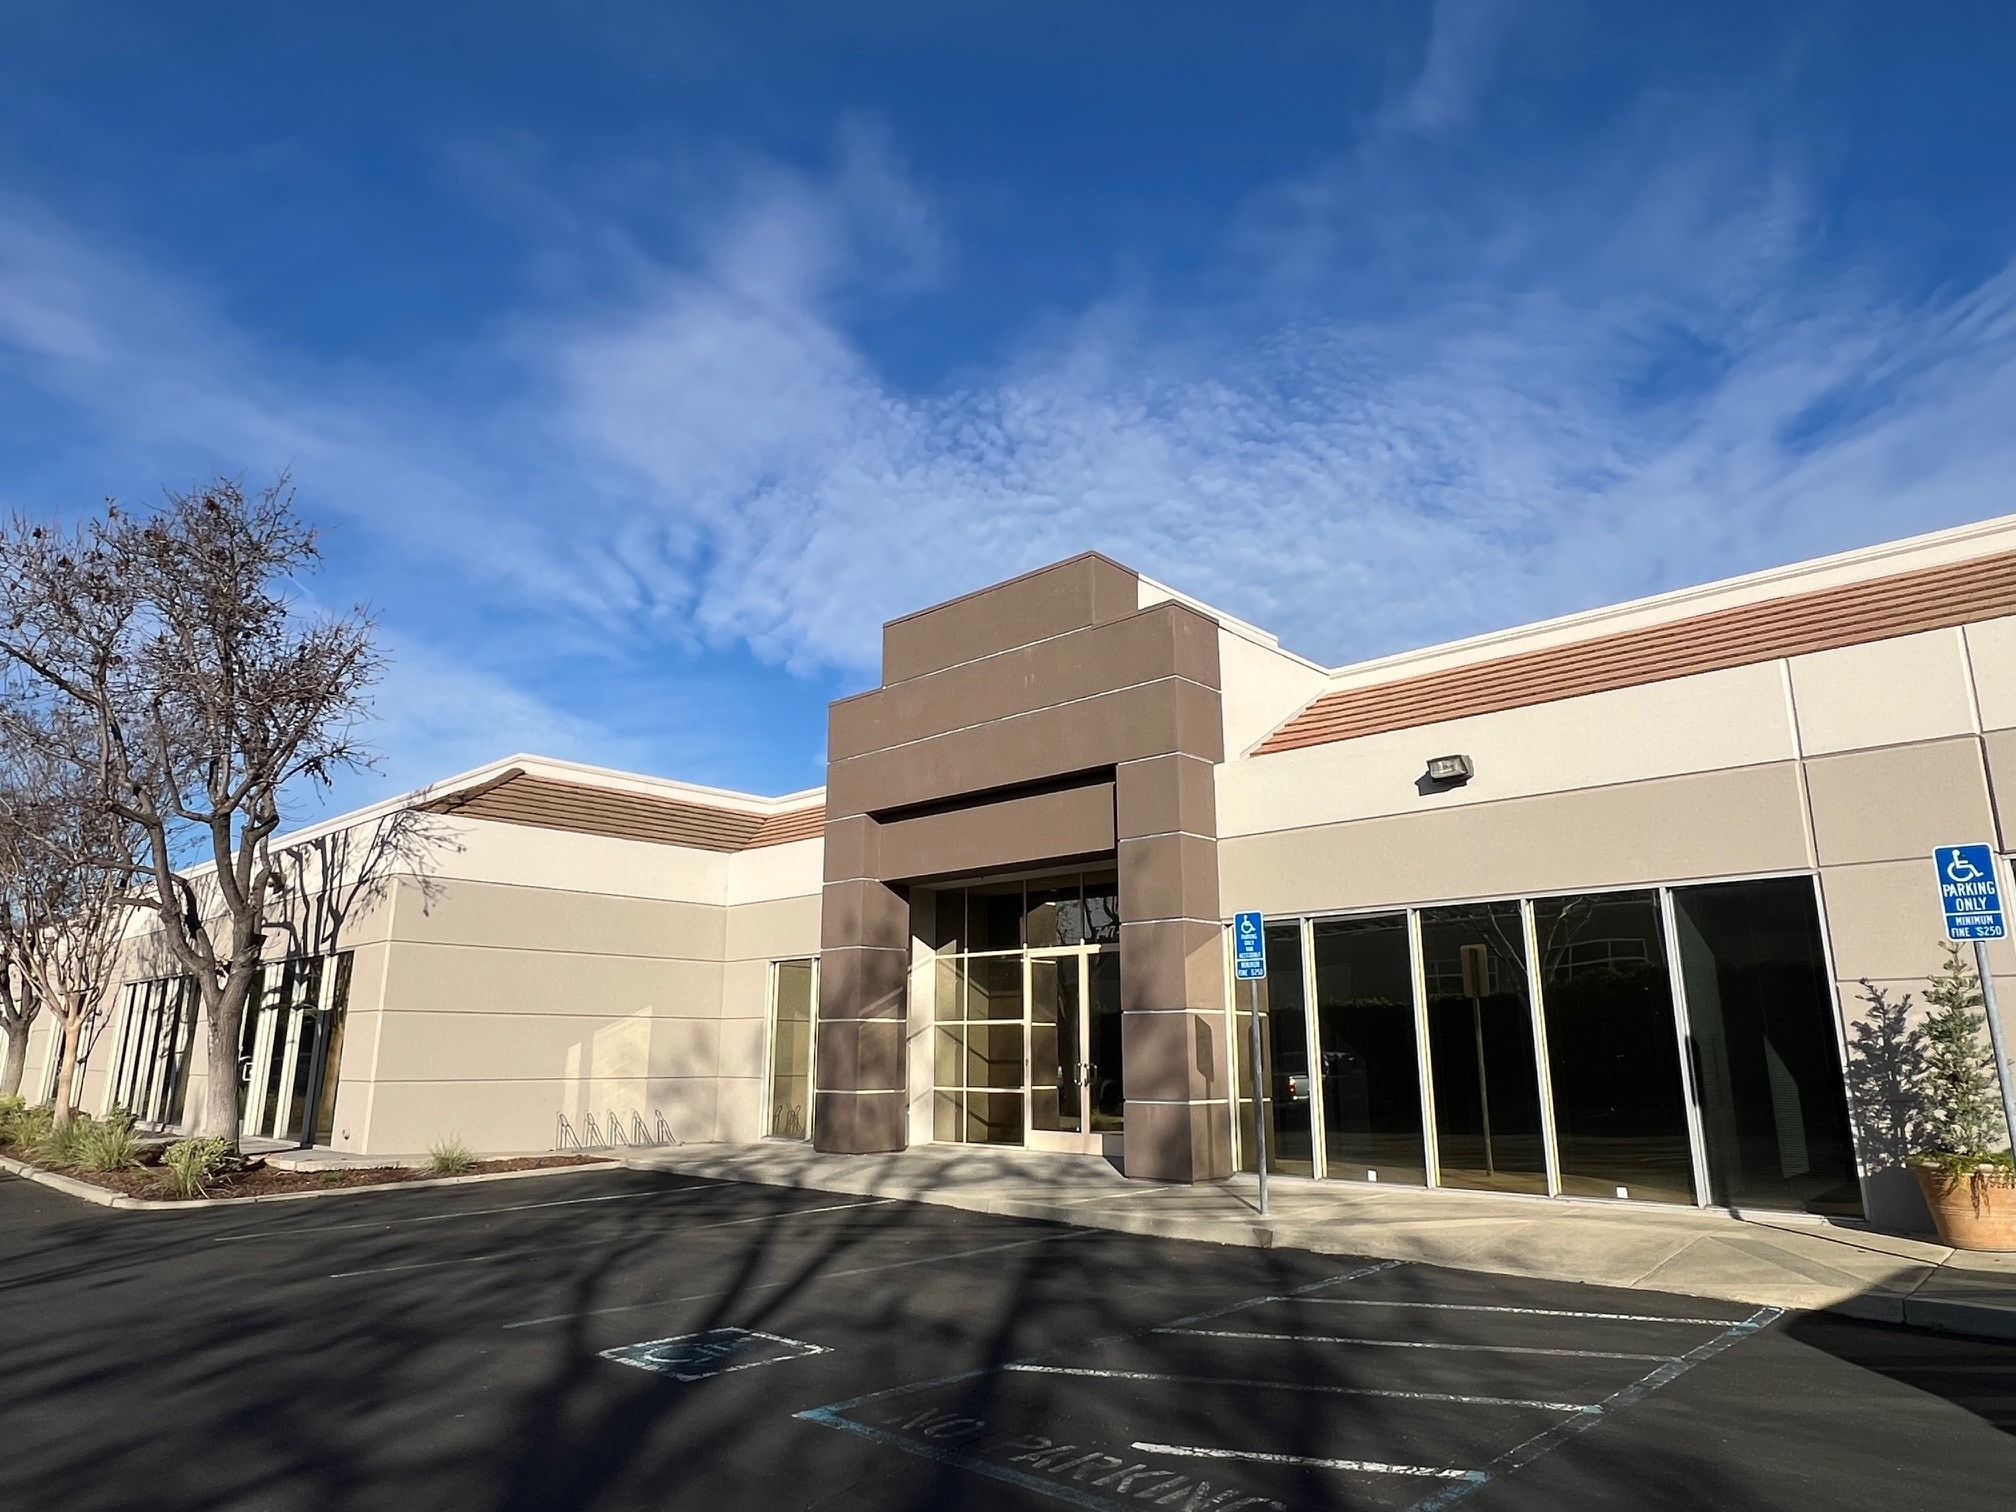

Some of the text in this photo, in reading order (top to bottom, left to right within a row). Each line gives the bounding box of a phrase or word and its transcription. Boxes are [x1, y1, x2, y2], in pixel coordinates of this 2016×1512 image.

[1943, 881, 1996, 897] PARKING
[1955, 897, 1987, 912] ONLY
[1955, 914, 1994, 926] MINIMUM
[1951, 925, 2002, 938] FINE $250
